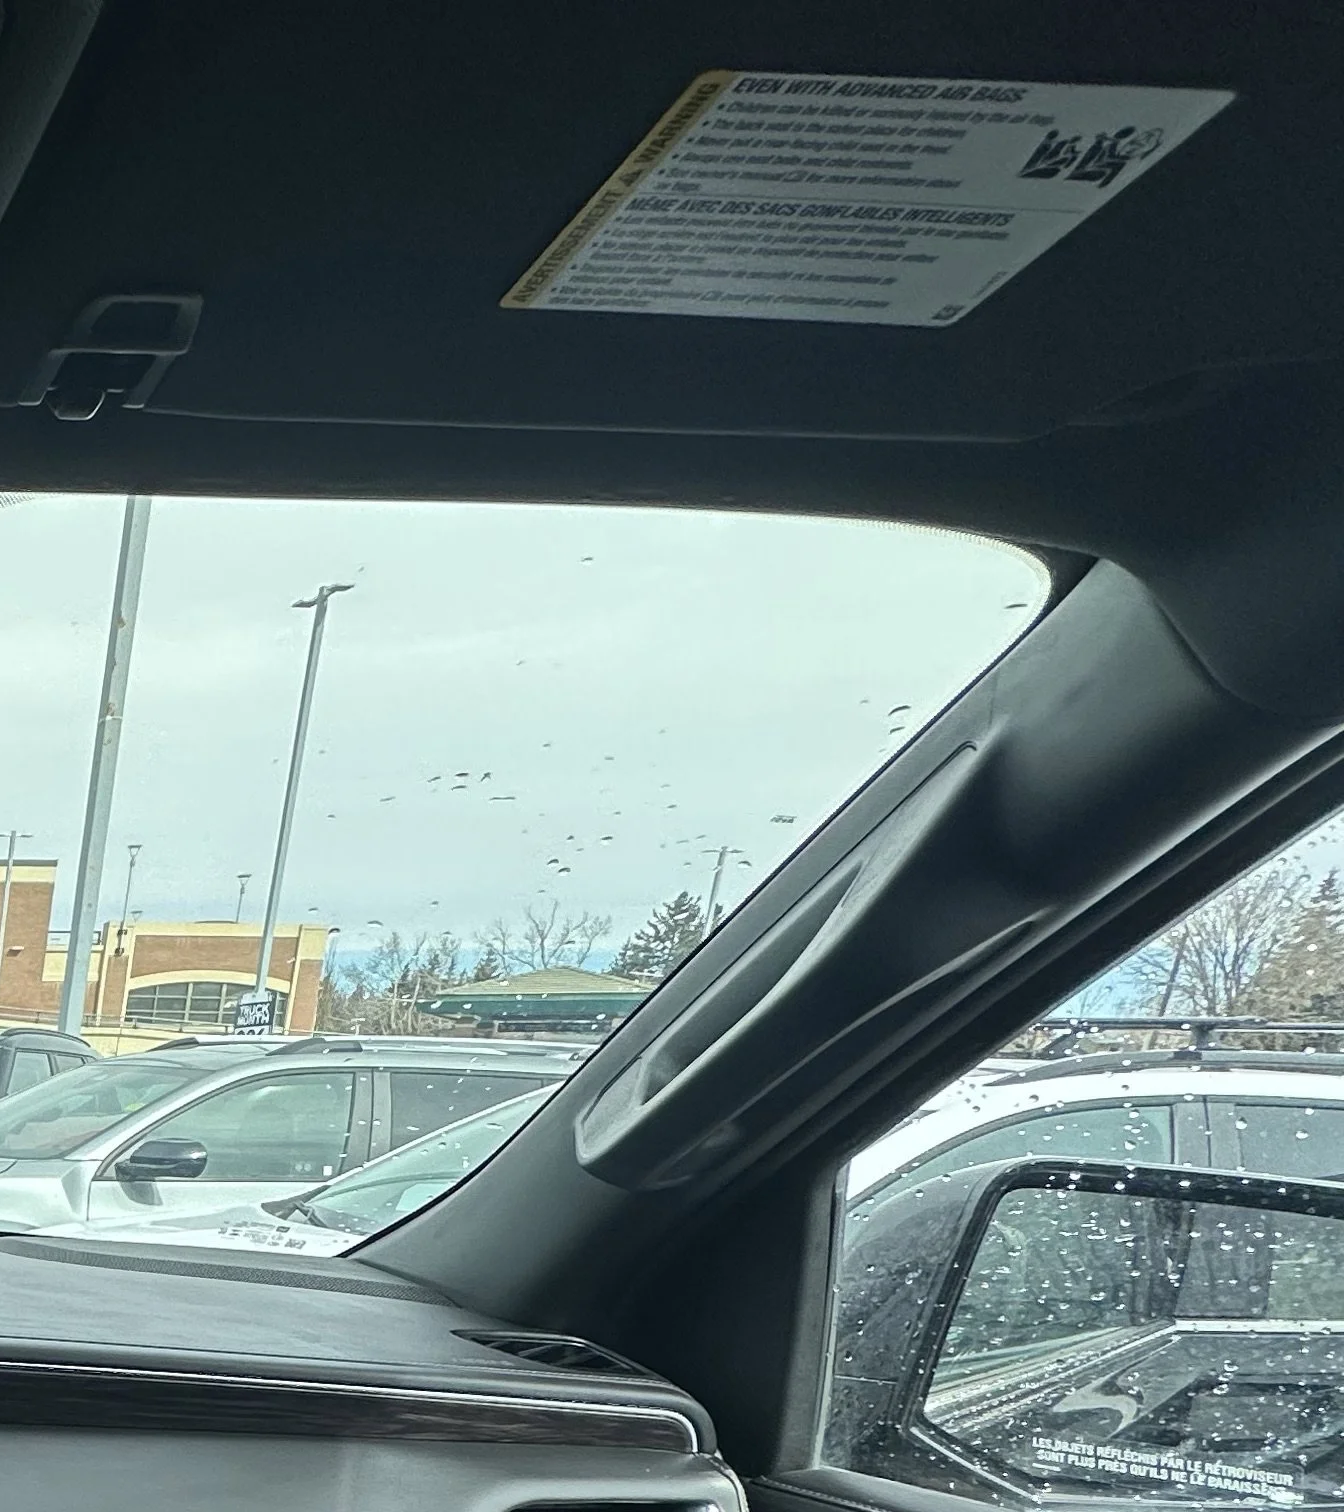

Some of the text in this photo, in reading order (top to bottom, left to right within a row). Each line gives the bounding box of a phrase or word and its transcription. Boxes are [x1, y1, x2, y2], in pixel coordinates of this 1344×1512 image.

[732, 77, 1028, 103] EVEN WITH ADVANCED AIR BAGS
[633, 82, 720, 164] WARNING
[674, 199, 721, 215] AVEC
[720, 200, 757, 216] DES
[757, 201, 798, 217] SACS
[797, 203, 900, 222] GONFLABLES
[900, 206, 1016, 227] INTELLIGENTS
[1032, 1436, 1054, 1449] LES
[1096, 1442, 1158, 1465] RÉFLÉCHIS
[1160, 1455, 1185, 1471] PAR
[1186, 1459, 1203, 1473] LE
[1205, 1459, 1294, 1487] RÉTROVISEUR
[1037, 1449, 1067, 1464] SONT
[1067, 1454, 1097, 1470] PLUS
[1097, 1456, 1128, 1475] PRÈS
[1130, 1463, 1169, 1481] QU'ILS
[1170, 1470, 1188, 1483] NE
[1207, 1475, 1287, 1499] PARAISSE
